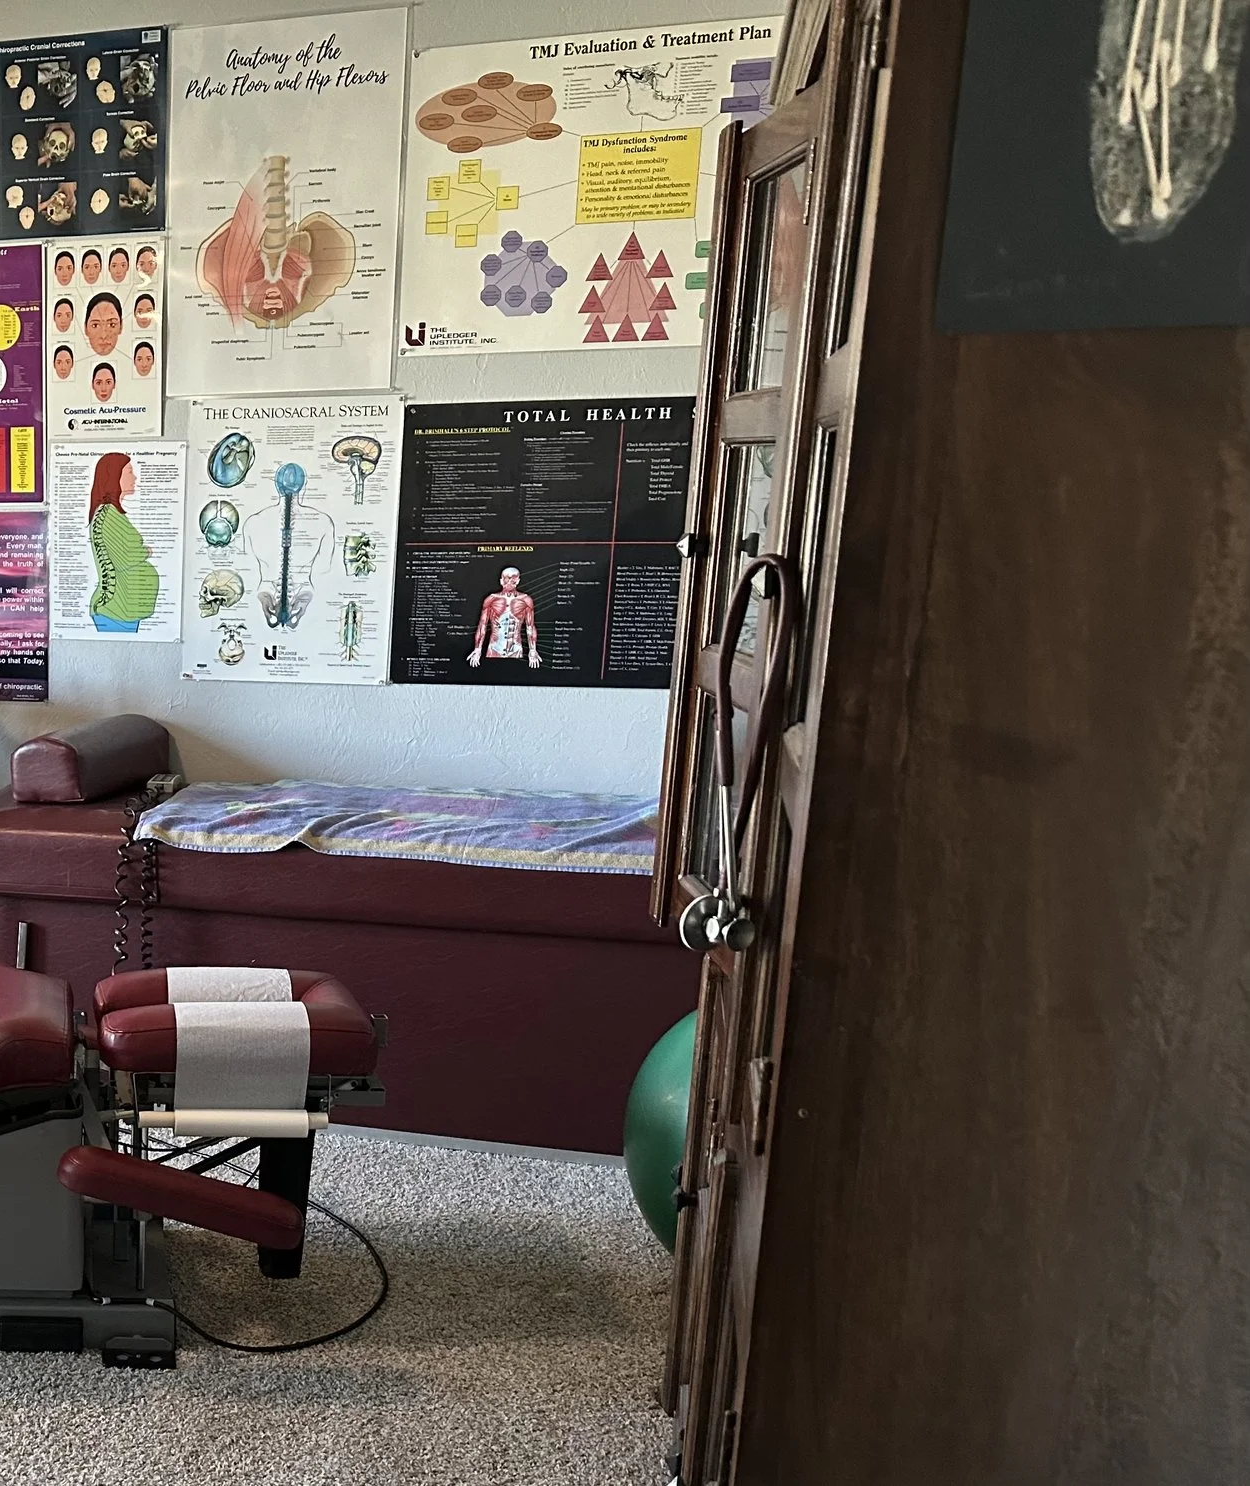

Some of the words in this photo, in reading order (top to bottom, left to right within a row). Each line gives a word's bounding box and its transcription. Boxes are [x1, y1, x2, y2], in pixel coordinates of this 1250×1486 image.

[30, 42, 50, 51] Cranial
[52, 40, 85, 49] Corrections
[530, 45, 559, 59] TMJ
[564, 38, 637, 56] Evaluation
[642, 35, 655, 49] &
[660, 28, 734, 47] Treatment
[739, 25, 771, 40] Plan
[226, 46, 291, 74] Anatomy
[295, 42, 314, 67] of
[316, 33, 342, 64] the
[185, 77, 228, 99] Pelvic
[231, 74, 270, 96] Floor
[274, 72, 302, 91] and
[306, 69, 332, 94] Hip
[335, 64, 390, 87] Flexors
[602, 136, 647, 147] Dysfunction
[649, 134, 688, 143] Syndrome
[203, 407, 229, 420] THE
[232, 406, 335, 420] CRANIOSACRAL
[339, 405, 389, 417] SYSTEM
[503, 409, 571, 423] TOTAL
[586, 407, 672, 421] HEALTH
